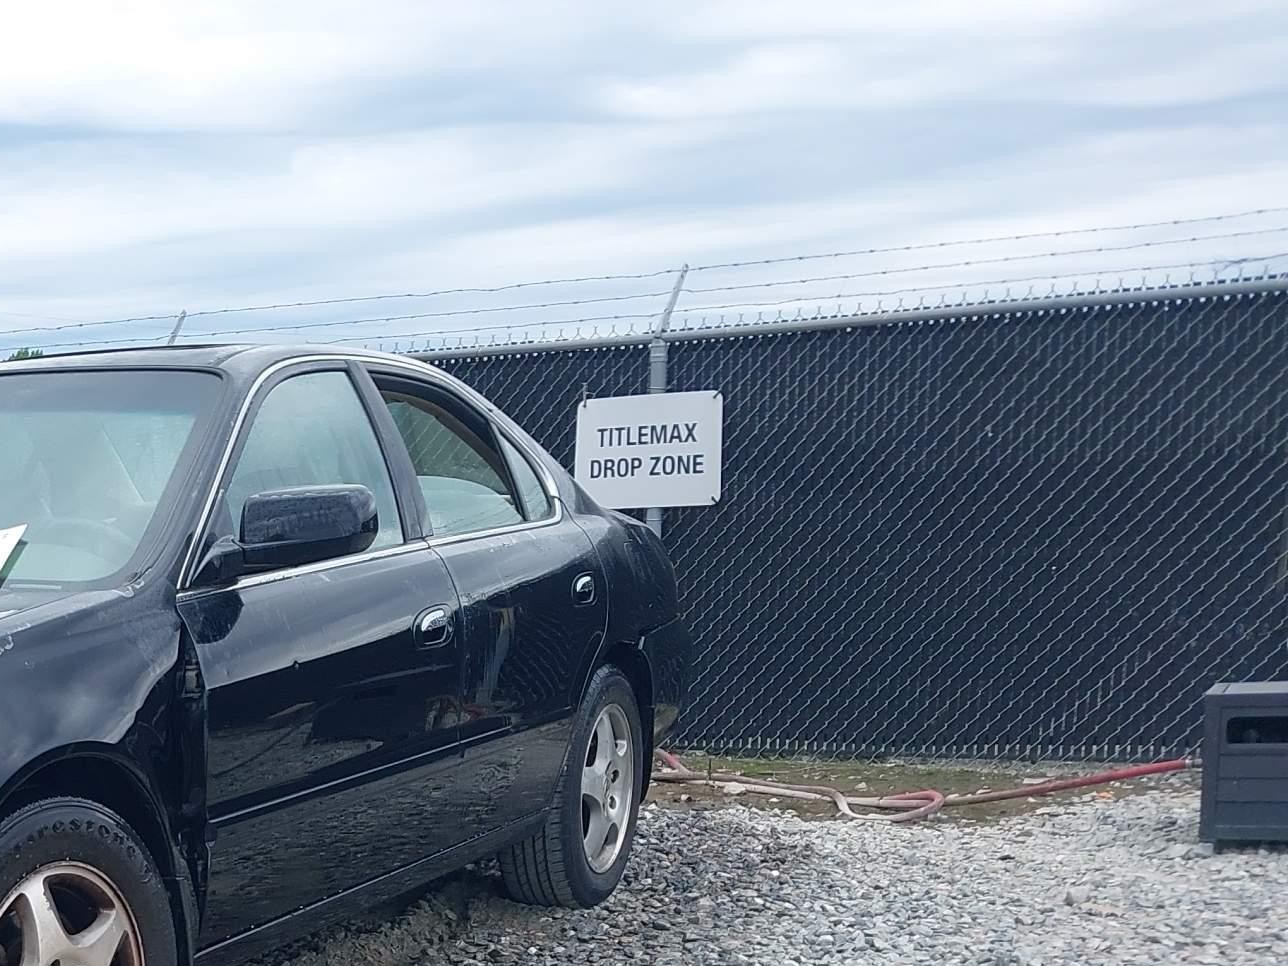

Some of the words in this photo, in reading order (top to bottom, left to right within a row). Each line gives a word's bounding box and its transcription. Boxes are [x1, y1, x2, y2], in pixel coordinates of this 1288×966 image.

[597, 422, 698, 448] TITLEMAX
[590, 457, 642, 479] DROP
[649, 454, 705, 476] ZONE
